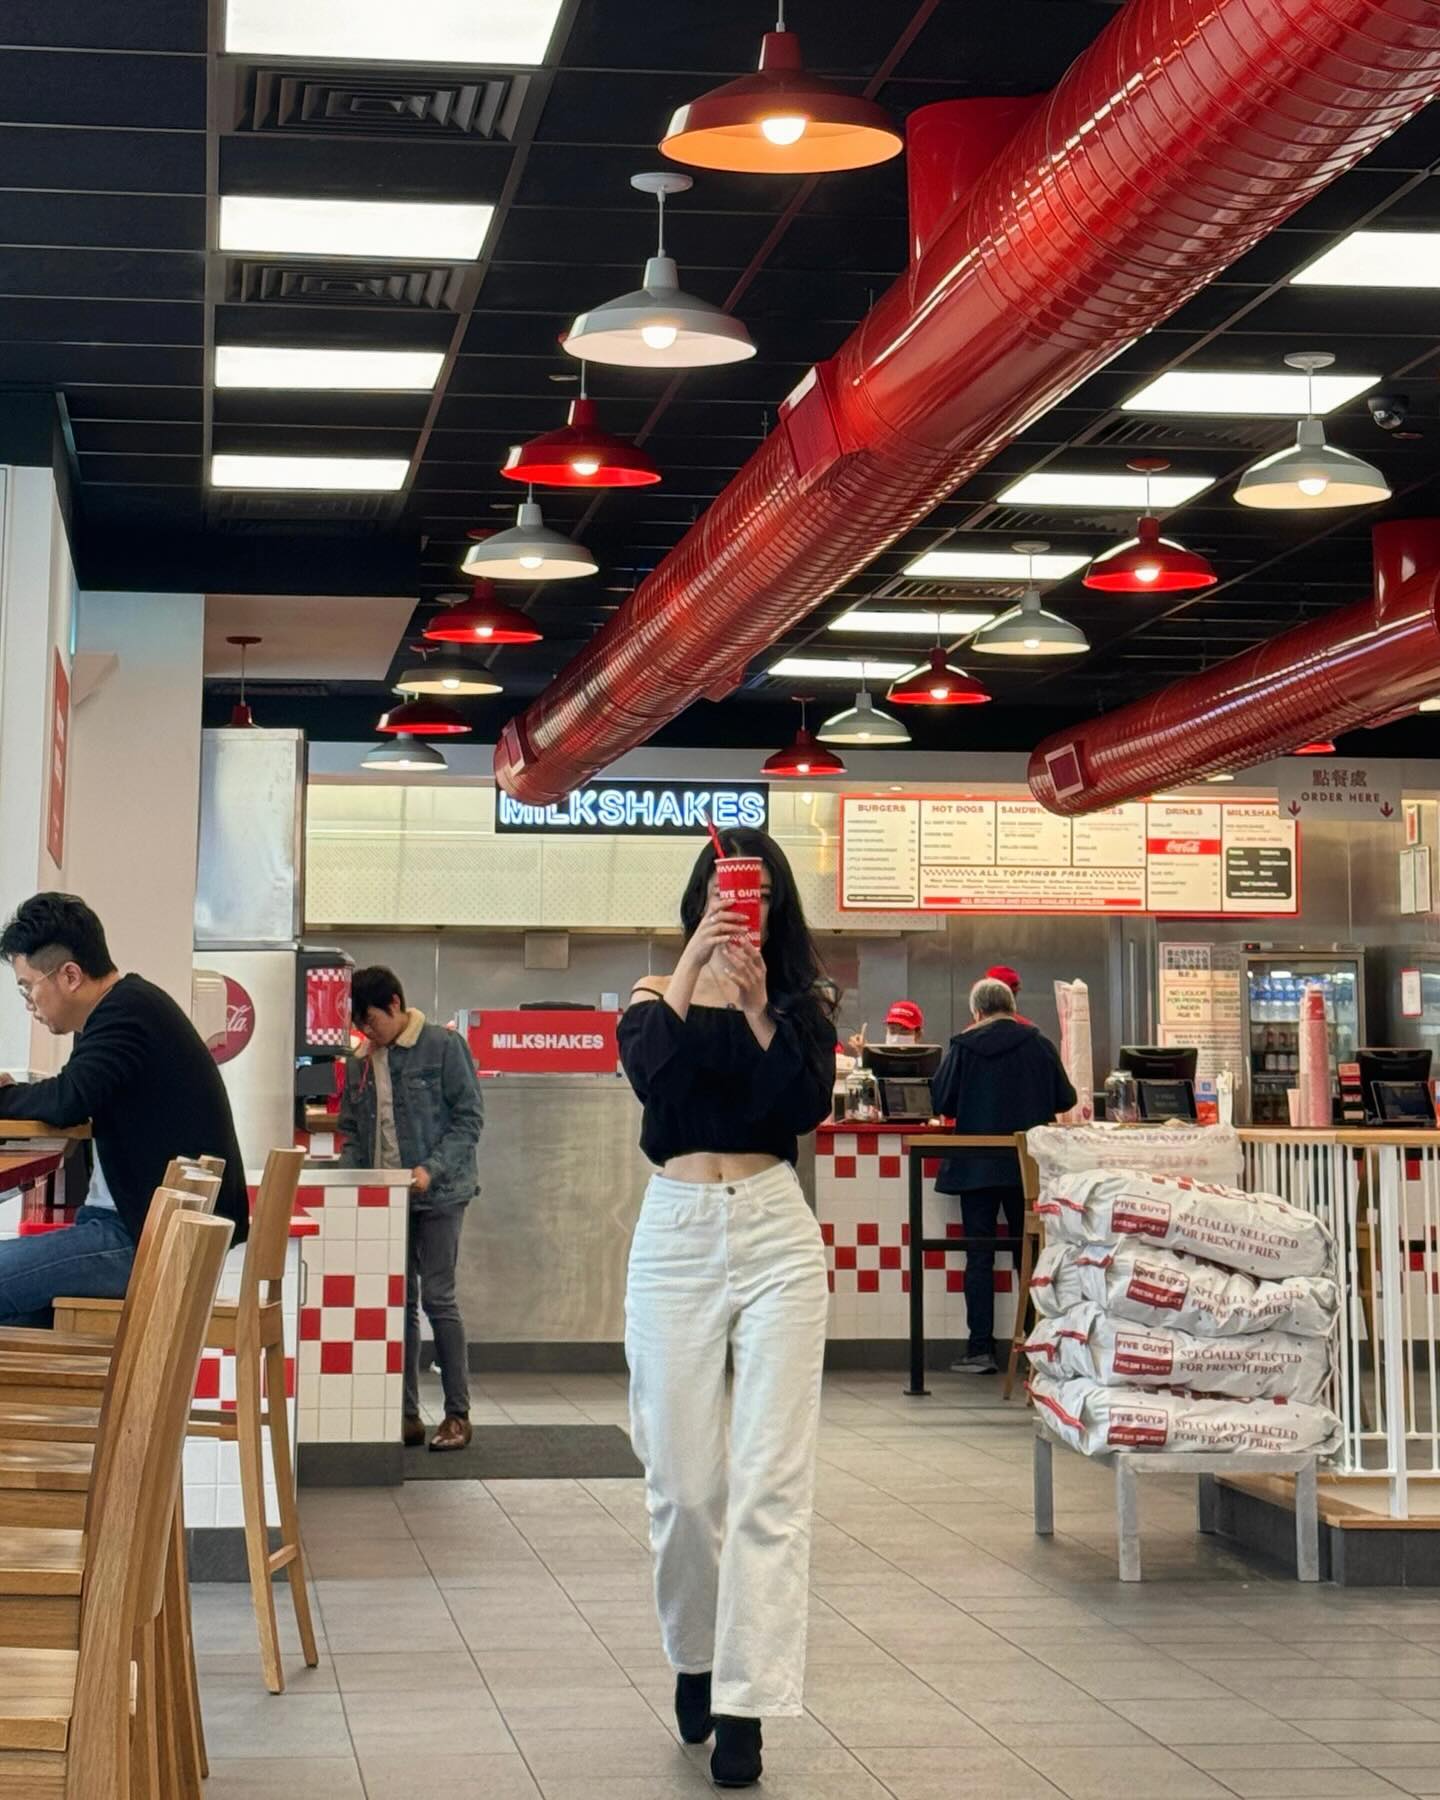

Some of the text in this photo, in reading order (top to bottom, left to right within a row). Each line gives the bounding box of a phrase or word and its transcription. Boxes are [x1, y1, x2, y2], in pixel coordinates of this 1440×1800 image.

[1312, 769, 1368, 787] 點餐處
[1300, 791, 1380, 803] ORDER HERE
[857, 804, 907, 813] BURGERS
[932, 805, 985, 814] HOT DOGS
[1165, 807, 1203, 816] DRINKS
[1226, 809, 1279, 817] MILKSHAK
[978, 869, 999, 877] ALL
[1003, 869, 1057, 878] TOPPINGS
[492, 1034, 604, 1049] MILKSHAKES
[1115, 1199, 1167, 1215] FIVE GUYS
[1177, 1212, 1299, 1250] SPECIALLY SELECTED
[1175, 1225, 1281, 1260] FOR FRENCH FRIES
[1191, 1298, 1215, 1314] FOR
[1117, 1340, 1170, 1354] FIVE GUYS
[1180, 1349, 1302, 1364] SPECIALLY SELECTED
[1179, 1363, 1204, 1374] FOR
[1206, 1363, 1252, 1375] FRENCH
[1112, 1412, 1164, 1425] FIVE GUYS
[1174, 1419, 1299, 1441] SPECIALLY SELECTED
[1173, 1430, 1282, 1450] FOR FRENCH FRIES
